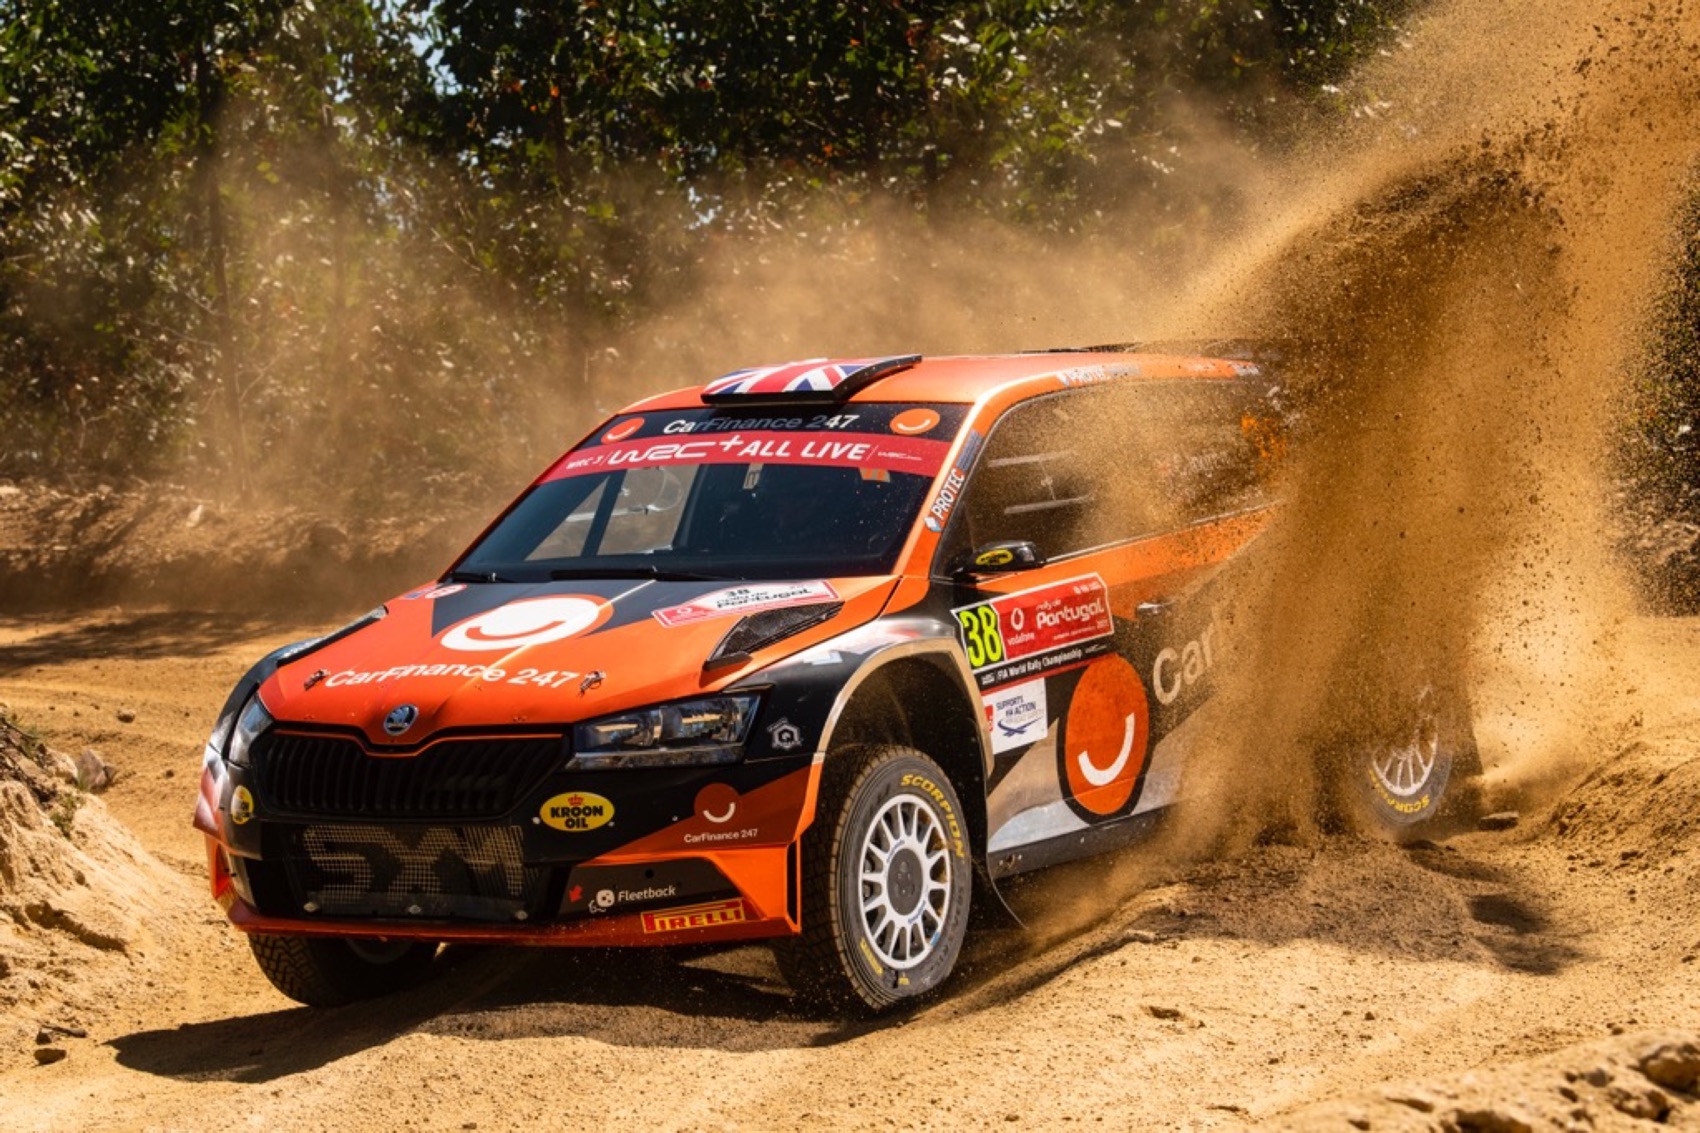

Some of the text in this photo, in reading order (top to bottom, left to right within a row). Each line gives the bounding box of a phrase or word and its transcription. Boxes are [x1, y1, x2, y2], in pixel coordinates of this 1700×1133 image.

[663, 414, 859, 434] CarFinance 247
[737, 440, 792, 457] ALL
[801, 441, 872, 460] LIVE
[931, 468, 965, 520] PROTEC
[1036, 598, 1105, 630] Portugal
[959, 606, 1002, 667] 38
[325, 663, 580, 689] CarFinance 247
[1009, 664, 1027, 677] World
[1027, 660, 1042, 672] Rally
[1042, 648, 1083, 667] Championship
[1153, 623, 1216, 705] Car
[551, 806, 603, 818] KROON
[565, 817, 588, 829] OIL
[901, 773, 965, 858] SCORPION
[684, 828, 758, 843] CarFinance 247
[618, 885, 676, 902] Fleetback
[643, 899, 744, 933] PIRELLI
